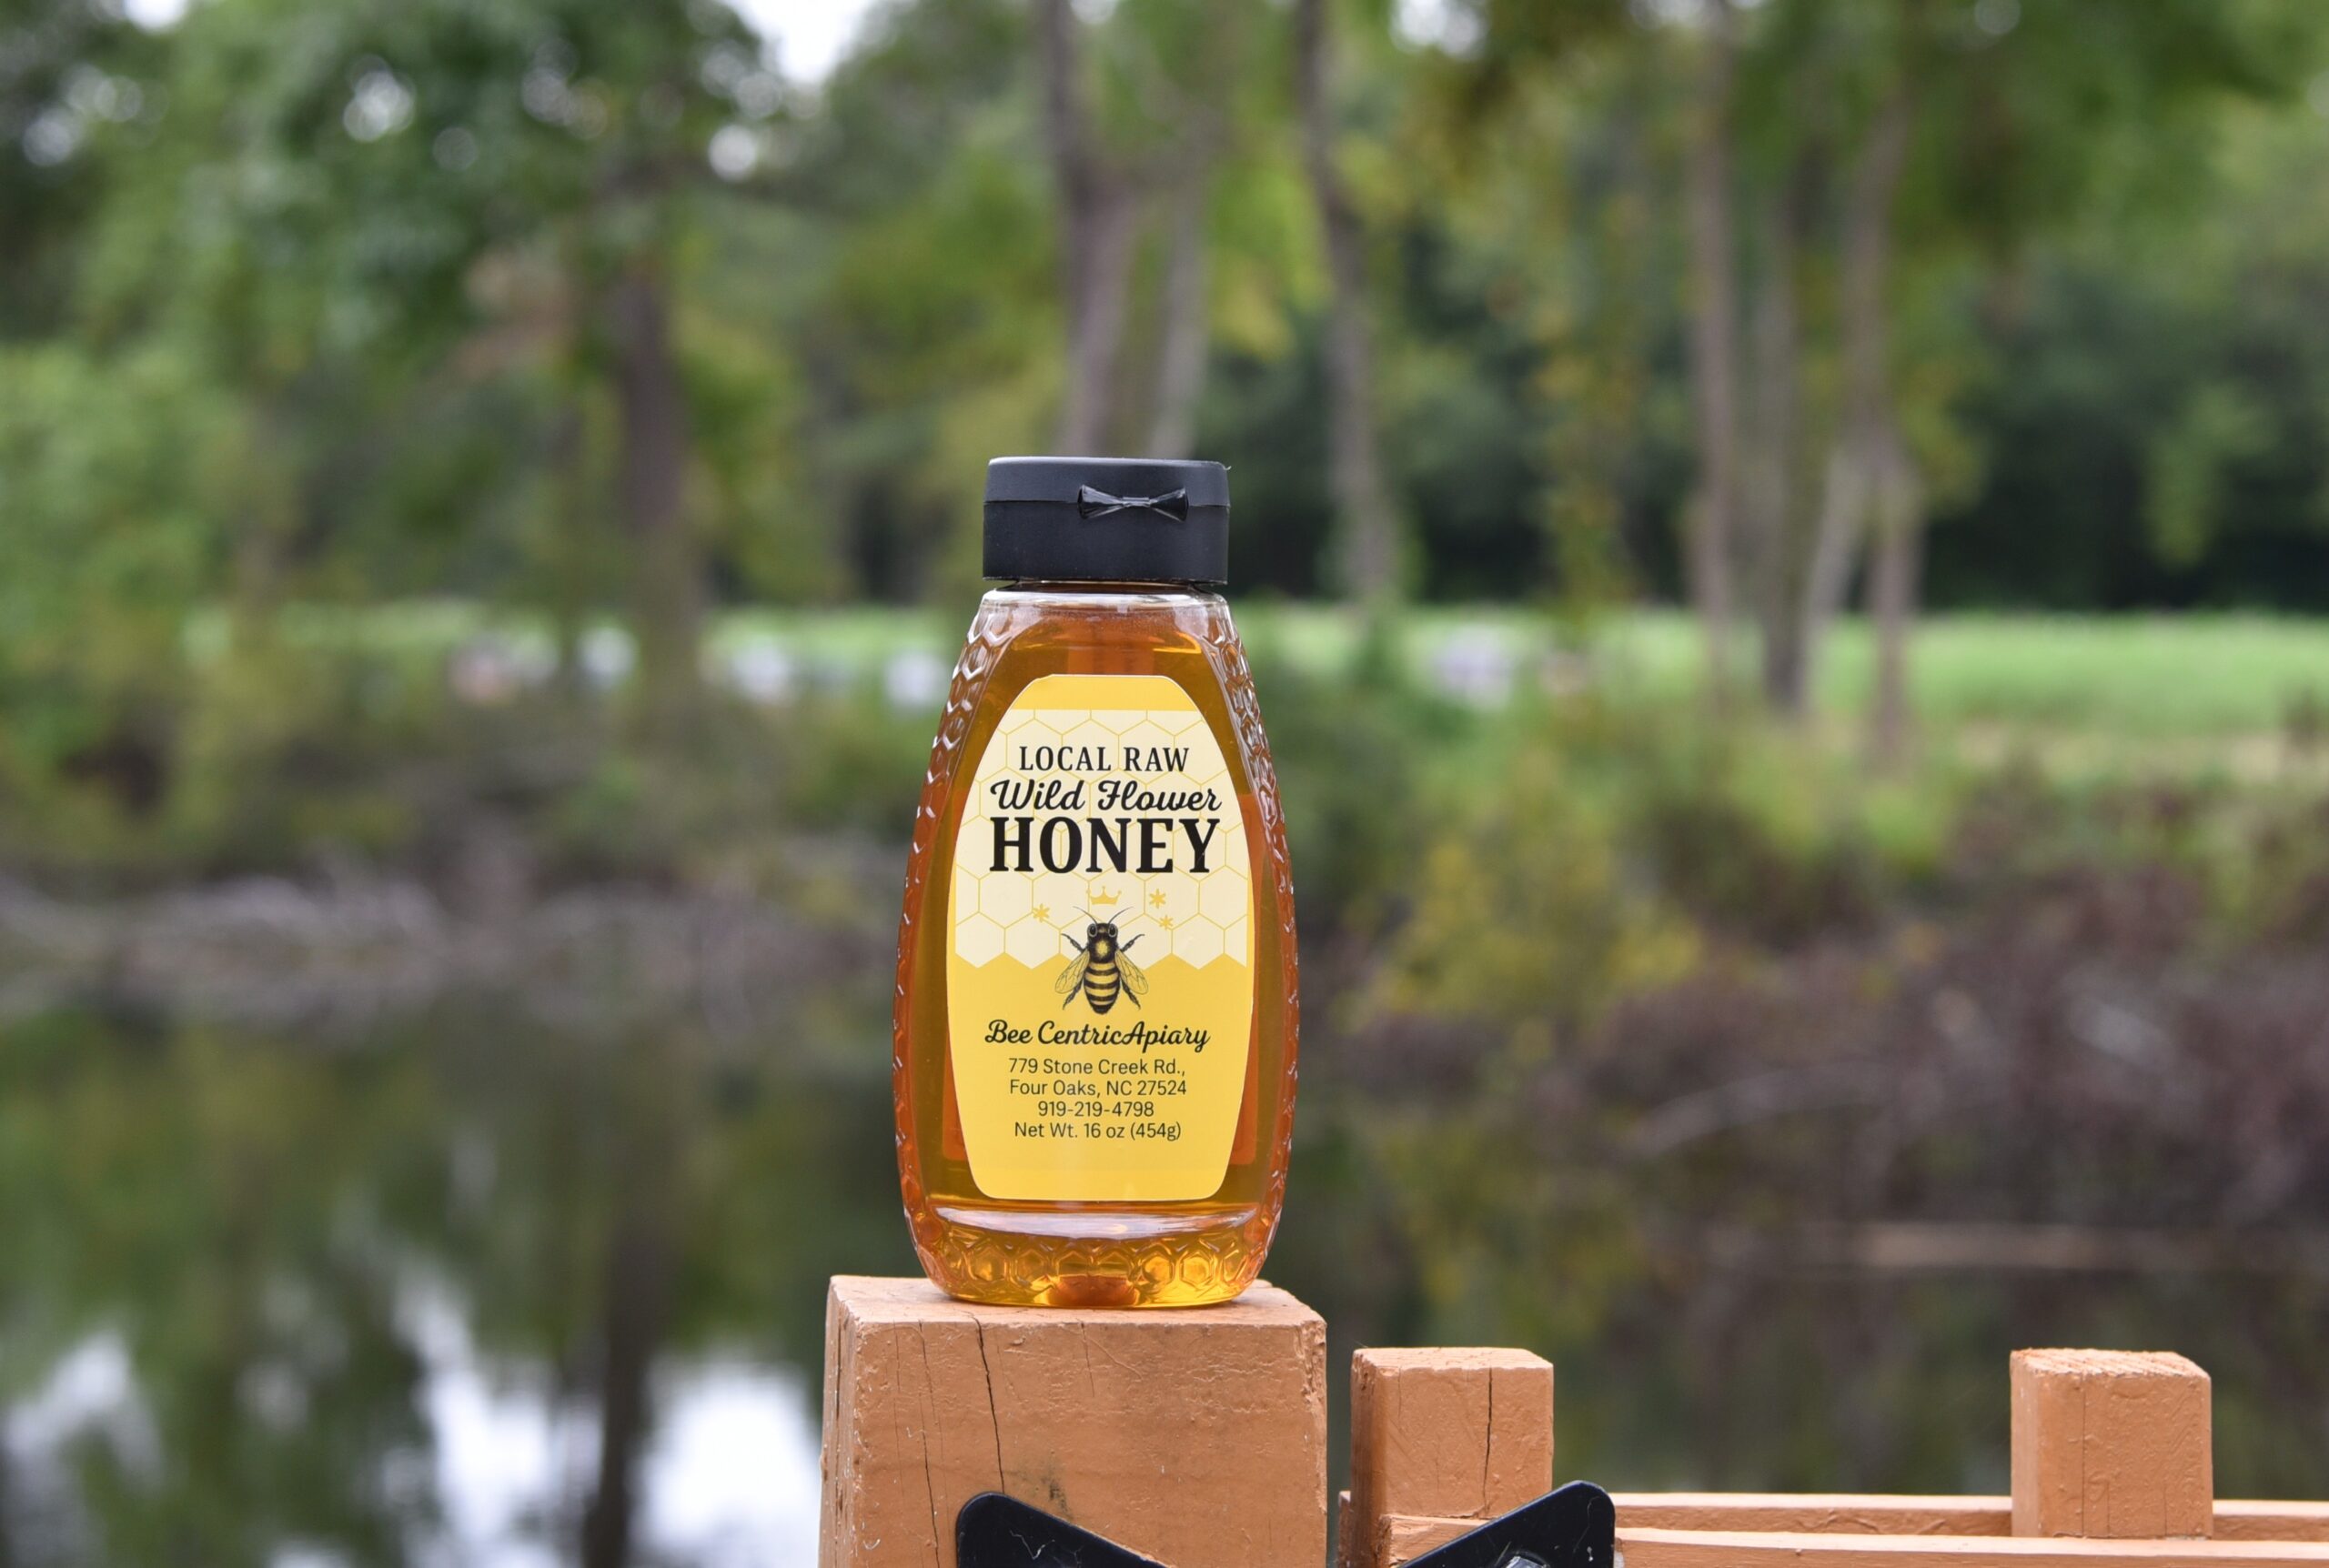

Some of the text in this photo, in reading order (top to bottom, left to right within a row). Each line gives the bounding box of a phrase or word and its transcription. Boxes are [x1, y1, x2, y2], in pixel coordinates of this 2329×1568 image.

[1018, 745, 1190, 773] LOCAL RAW
[989, 778, 1223, 812] Wild Flower
[988, 816, 1221, 874] HONEY
[983, 1019, 1033, 1045] Bee
[1008, 1057, 1185, 1077] 779 Stone Creek Rd.,
[1010, 1079, 1187, 1099] Four Oaks, NC 27524
[1037, 1100, 1154, 1118] 919-219-4798
[1014, 1121, 1182, 1142] Net Wt. 16 oz (454g)
